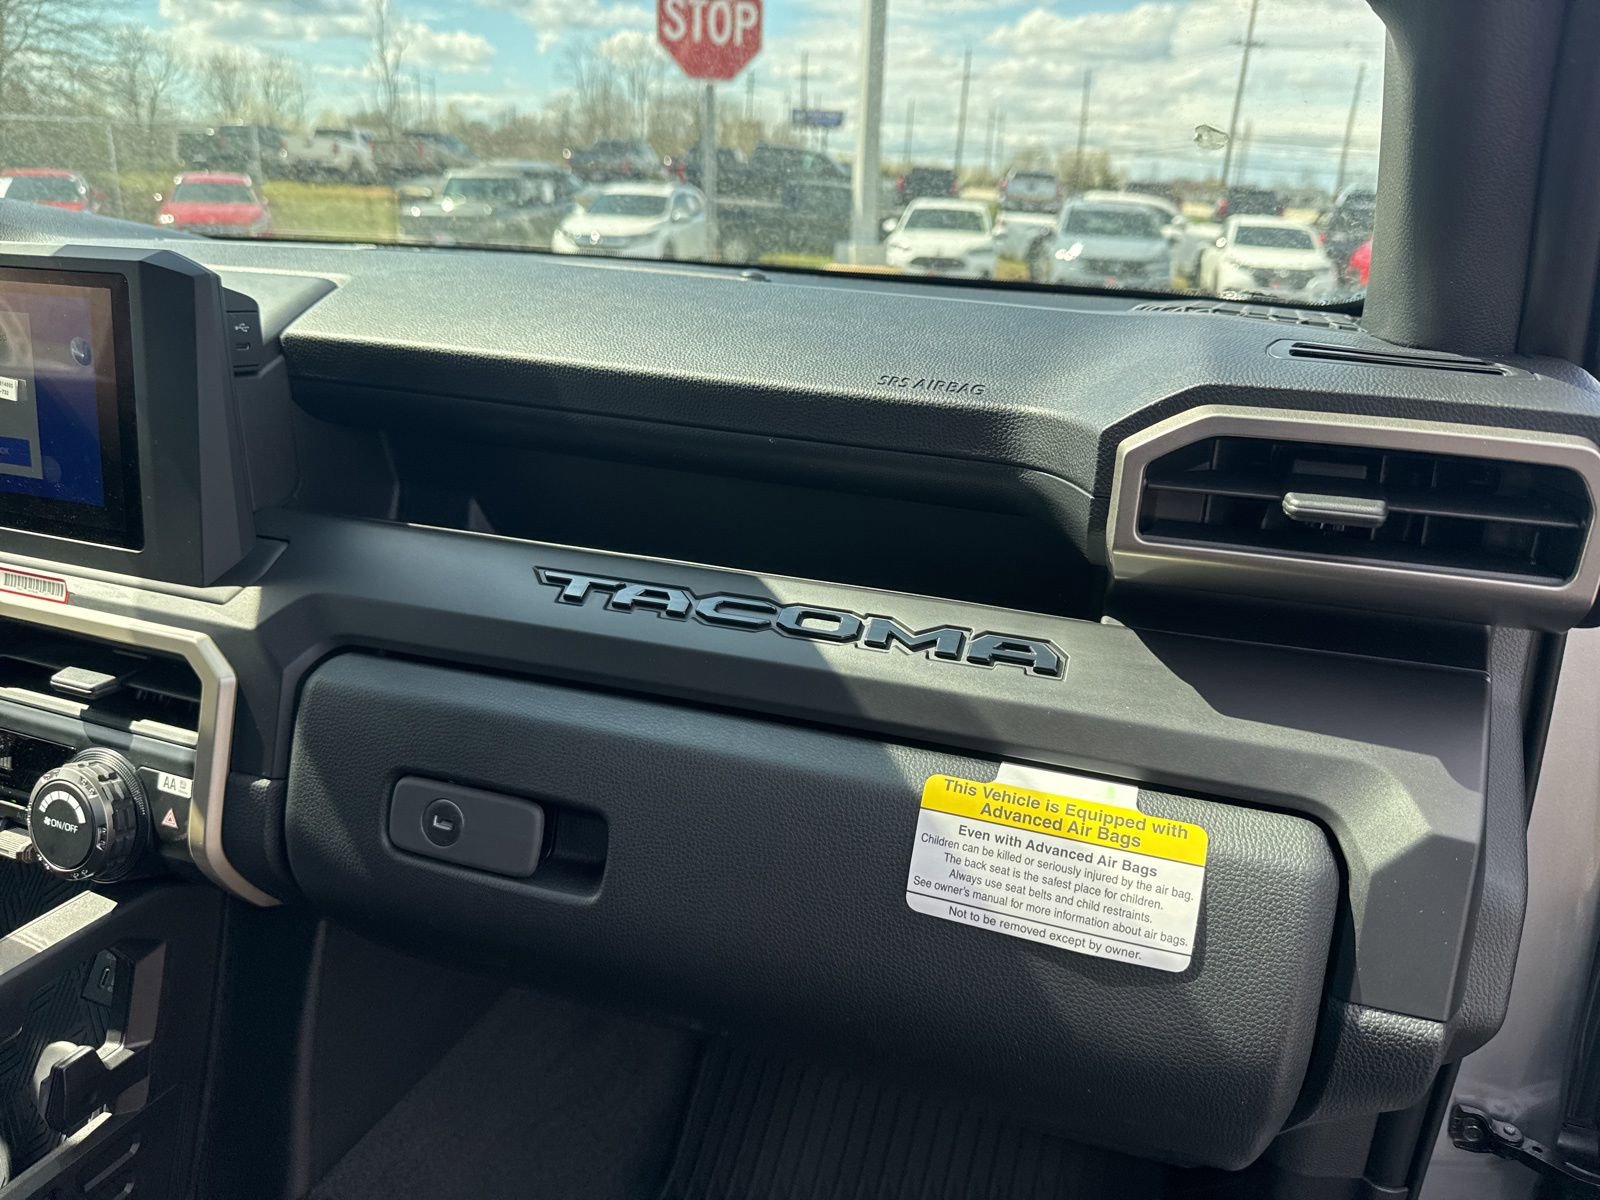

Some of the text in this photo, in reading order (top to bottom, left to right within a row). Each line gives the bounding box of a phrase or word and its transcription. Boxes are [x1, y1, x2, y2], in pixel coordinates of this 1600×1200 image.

[663, 0, 758, 46] STOP
[877, 375, 986, 395] SRS AIRBAG
[538, 567, 1067, 679] TACOMA
[51, 818, 78, 833] ON/OFF
[944, 778, 1188, 840] This Vehicle is Equipped with
[980, 802, 1141, 848] Advanced Air Bags
[921, 832, 1194, 902] Children can be killed or seriously injured by the air bag.
[958, 824, 1158, 878] Even with Advanced Air Bags
[944, 851, 1164, 910] The back seat is the safest place for children.
[949, 868, 1153, 924] Always use seat belts and child restraints.
[913, 875, 932, 888] See
[972, 892, 1008, 906] manual
[1010, 897, 1022, 910] for
[1025, 902, 1051, 916] more
[1053, 907, 1110, 930] information
[1112, 922, 1141, 937] about
[1143, 929, 1158, 940] air
[1160, 931, 1188, 947] bags.
[949, 906, 1142, 960] Not to be removed except by owner.
